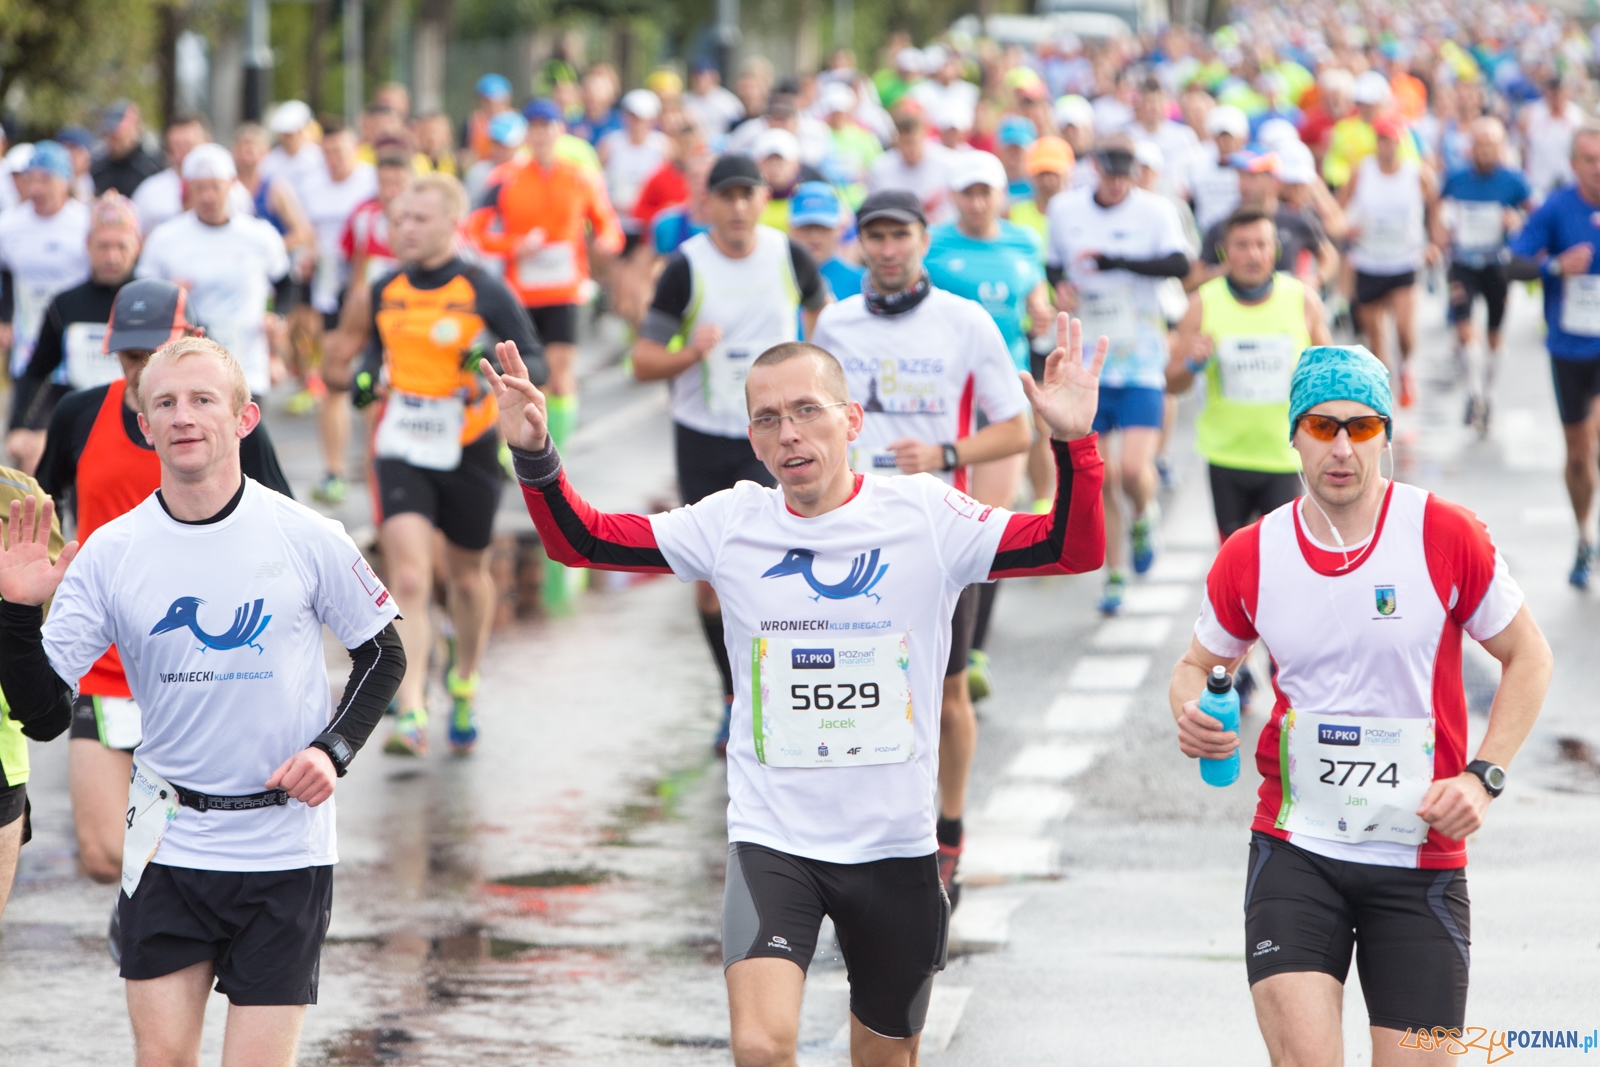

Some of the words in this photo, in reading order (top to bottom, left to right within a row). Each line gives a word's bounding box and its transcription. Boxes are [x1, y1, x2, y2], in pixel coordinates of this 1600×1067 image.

[760, 620, 829, 631] WRONIECKI
[829, 621, 850, 630] KLUB
[852, 620, 892, 630] BIEGACZA
[838, 657, 875, 665] maraton
[214, 672, 235, 681] KLUB
[236, 671, 274, 680] BIEGACZA
[791, 682, 880, 710] 5629
[817, 717, 856, 729] Jacek
[1365, 736, 1400, 744] maraton
[1319, 758, 1400, 788] 2774
[1344, 795, 1368, 806] Jan
[126, 805, 136, 829] 4
